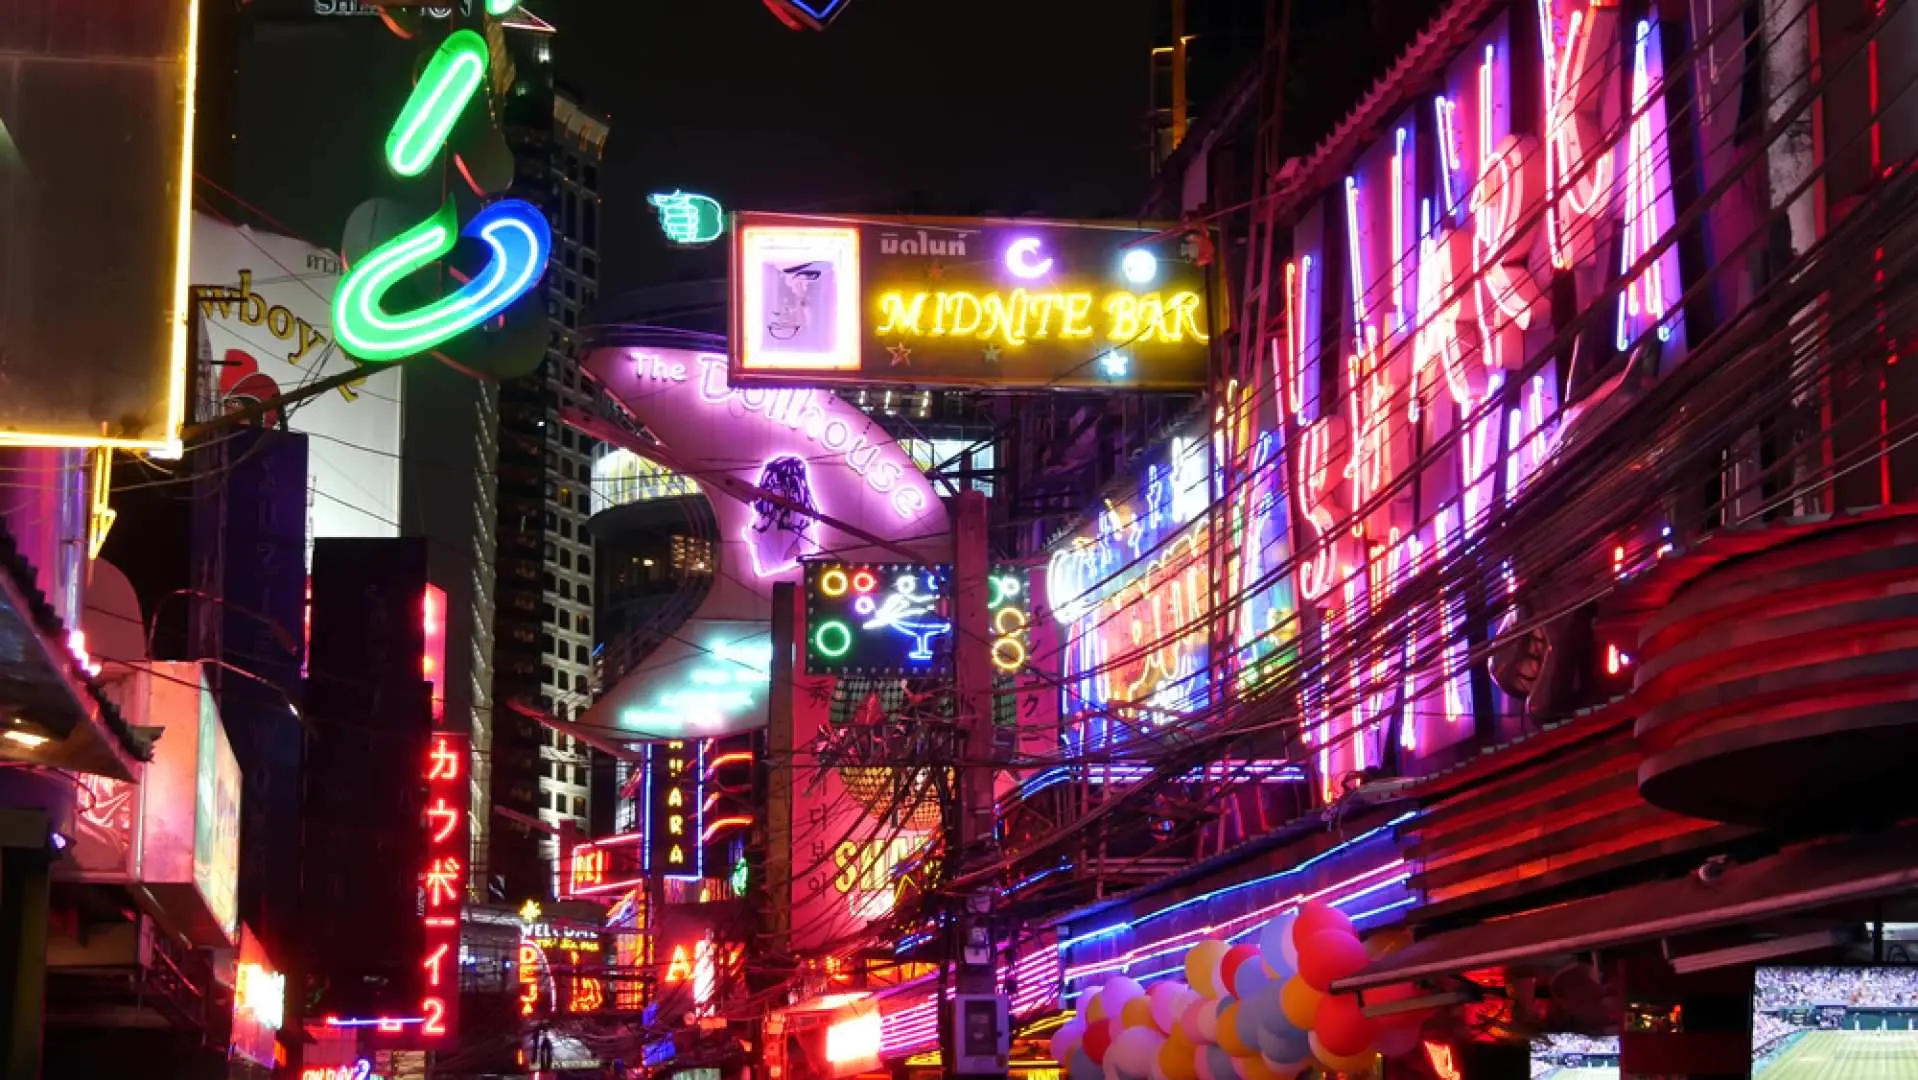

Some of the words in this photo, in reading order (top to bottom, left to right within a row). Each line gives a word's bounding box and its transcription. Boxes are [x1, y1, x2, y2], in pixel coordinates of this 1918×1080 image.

[876, 288, 1094, 346] MIDNITE
[1105, 291, 1211, 341] BAR
[629, 352, 688, 382] The
